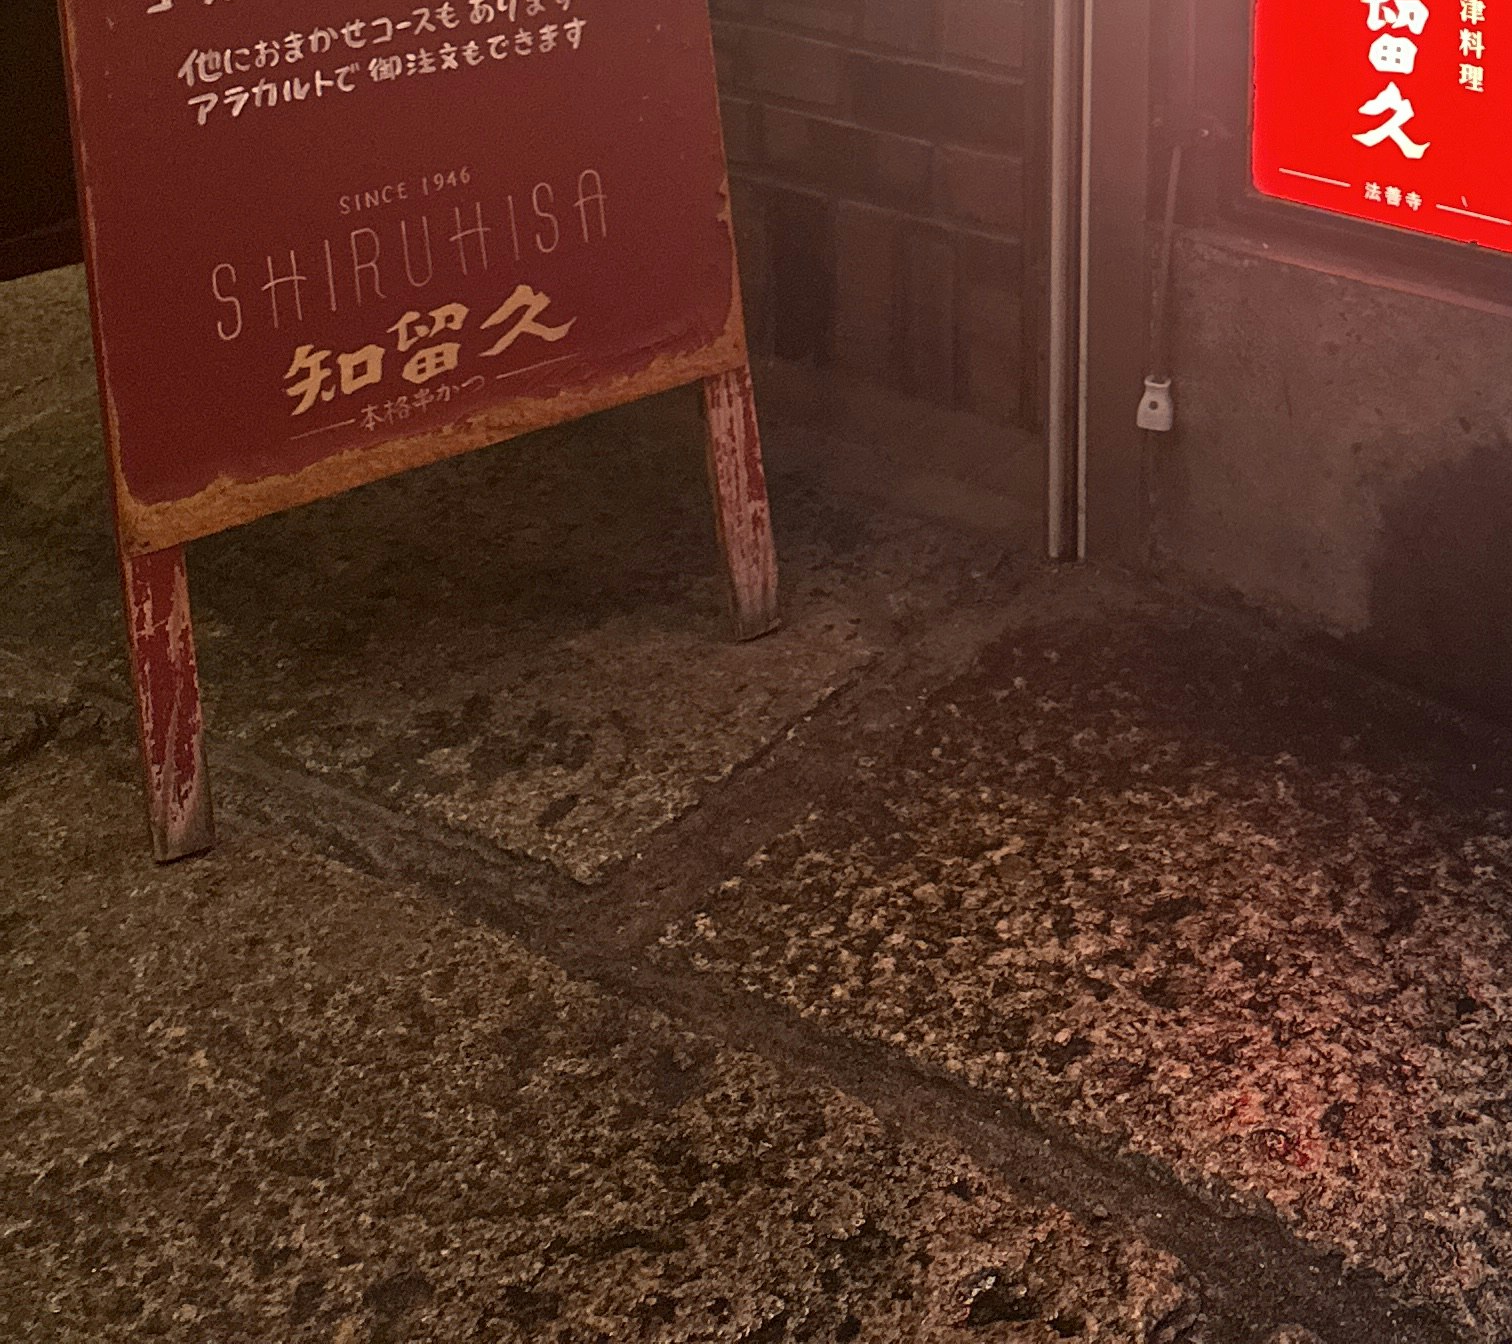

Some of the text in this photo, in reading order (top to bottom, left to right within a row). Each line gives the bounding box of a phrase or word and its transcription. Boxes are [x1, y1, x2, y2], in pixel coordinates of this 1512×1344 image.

[338, 165, 473, 216] SINCE 1946
[1363, 181, 1424, 212] 法善寺
[211, 168, 608, 342] SHIRUHISA
[283, 283, 578, 417] 知留久
